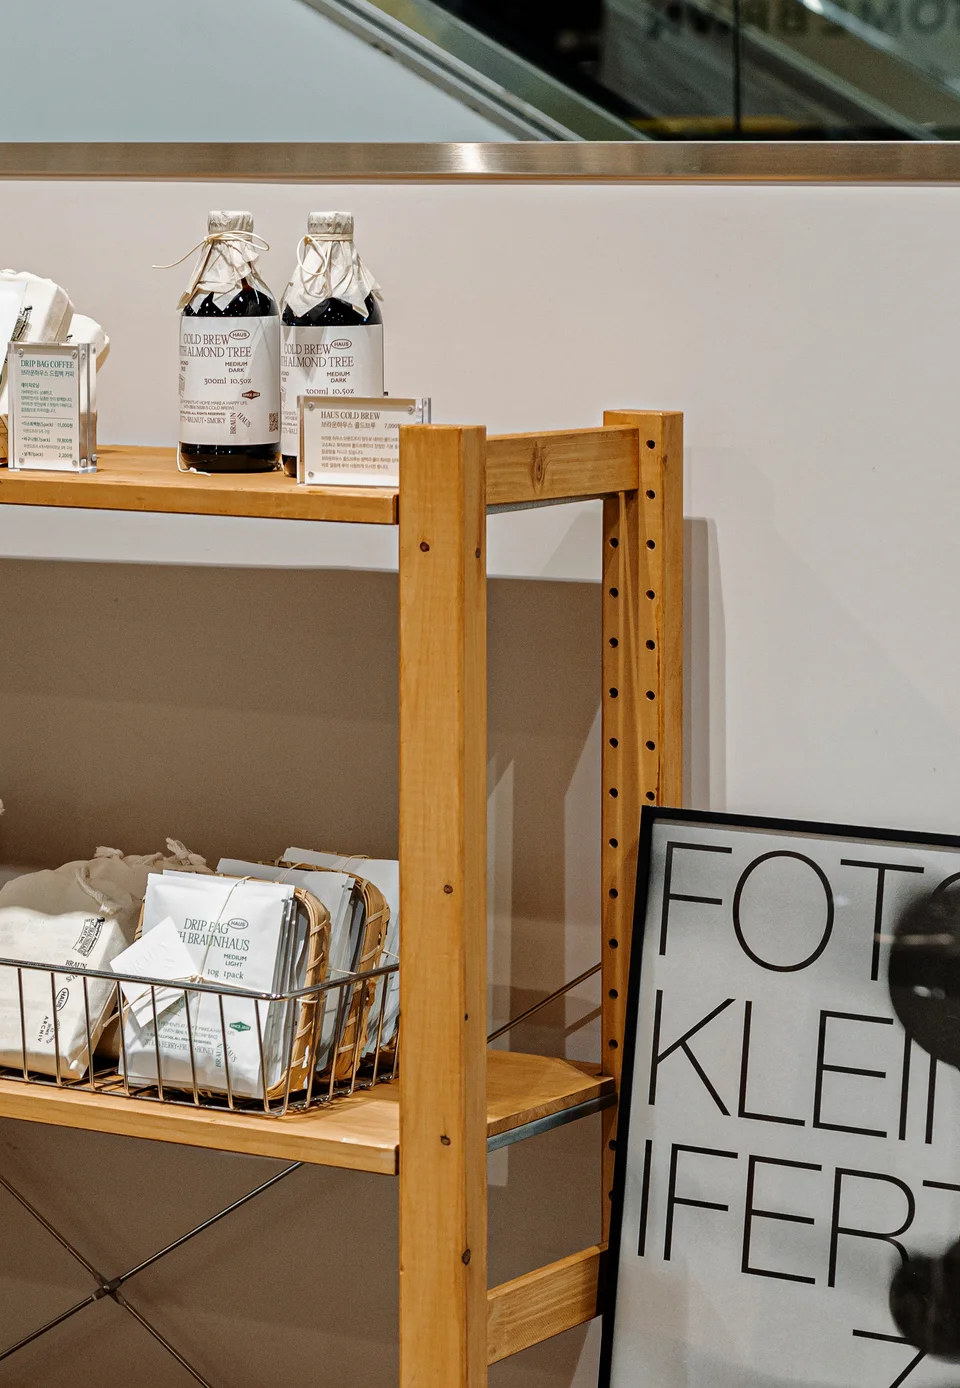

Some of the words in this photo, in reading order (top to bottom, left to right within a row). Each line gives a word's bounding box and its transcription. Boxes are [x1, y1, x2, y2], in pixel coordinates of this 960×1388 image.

[183, 333, 201, 345] COLD
[203, 334, 230, 345] BREW
[187, 346, 225, 357] ALMOND
[226, 346, 252, 357] TREE
[284, 343, 302, 354] COLD
[304, 344, 332, 354] BREW
[20, 359, 36, 367] DRIP
[36, 360, 49, 368] BAG
[50, 360, 74, 369] COFFEE
[286, 356, 327, 368] ALMOND
[328, 356, 355, 367] TREE
[204, 377, 227, 385] 300ml
[237, 412, 252, 428] HAUS
[320, 411, 340, 419] HAUS
[340, 411, 359, 419] COLD
[360, 412, 381, 420] BREW
[183, 918, 208, 931] DRIP
[188, 930, 251, 952] BRAUNHAUS
[223, 953, 248, 961] MEDIUM
[225, 960, 244, 968] LIGHT
[207, 968, 220, 978] 10g
[223, 970, 245, 980] 1pack
[38, 1015, 49, 1043] ARCHIV
[215, 1043, 223, 1068] BRAUN
[647, 988, 942, 1146] KLEI
